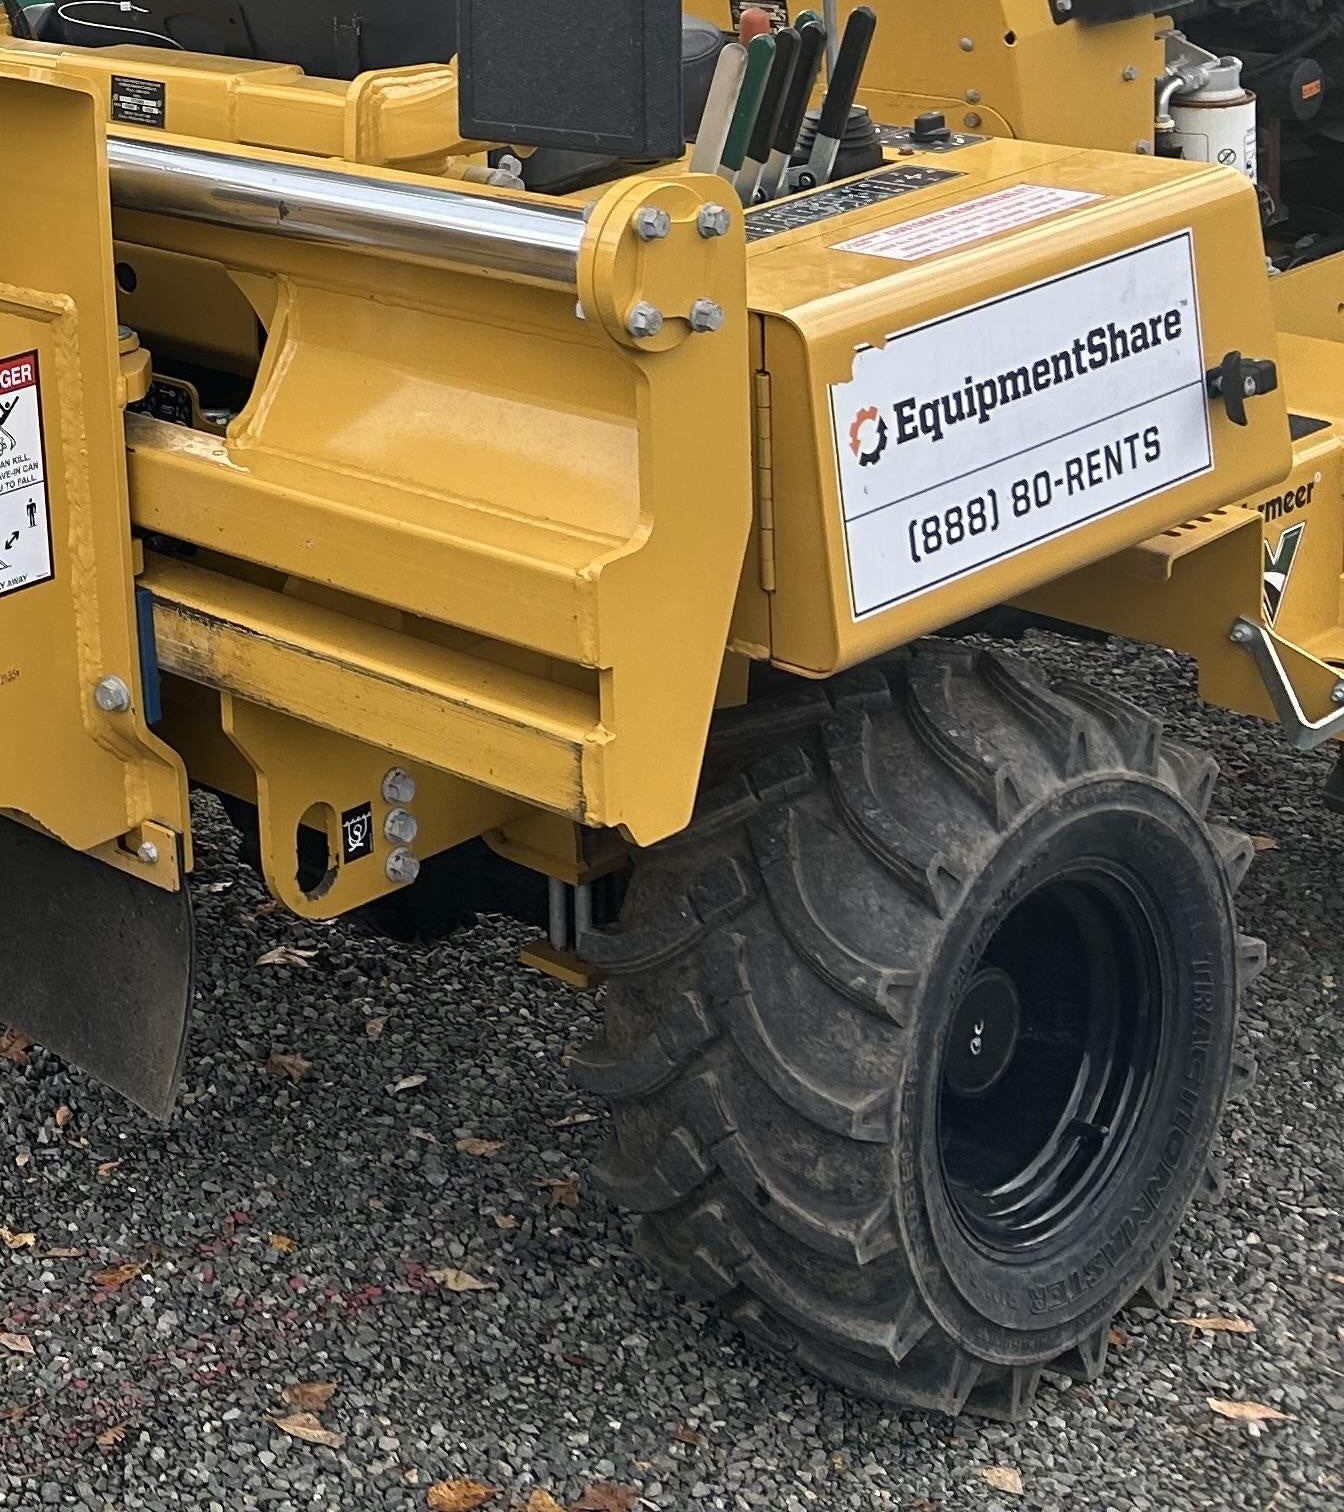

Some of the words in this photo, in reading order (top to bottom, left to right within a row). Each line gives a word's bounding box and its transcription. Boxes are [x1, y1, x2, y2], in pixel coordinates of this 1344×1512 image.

[892, 306, 1183, 446] EquipmentShare
[22, 462, 39, 473] CAN
[5, 481, 16, 492] TO
[908, 492, 1000, 563] (888)
[1013, 426, 1162, 518] 80-RENTS
[1241, 481, 1315, 523] meer
[7, 574, 28, 589] AWAY
